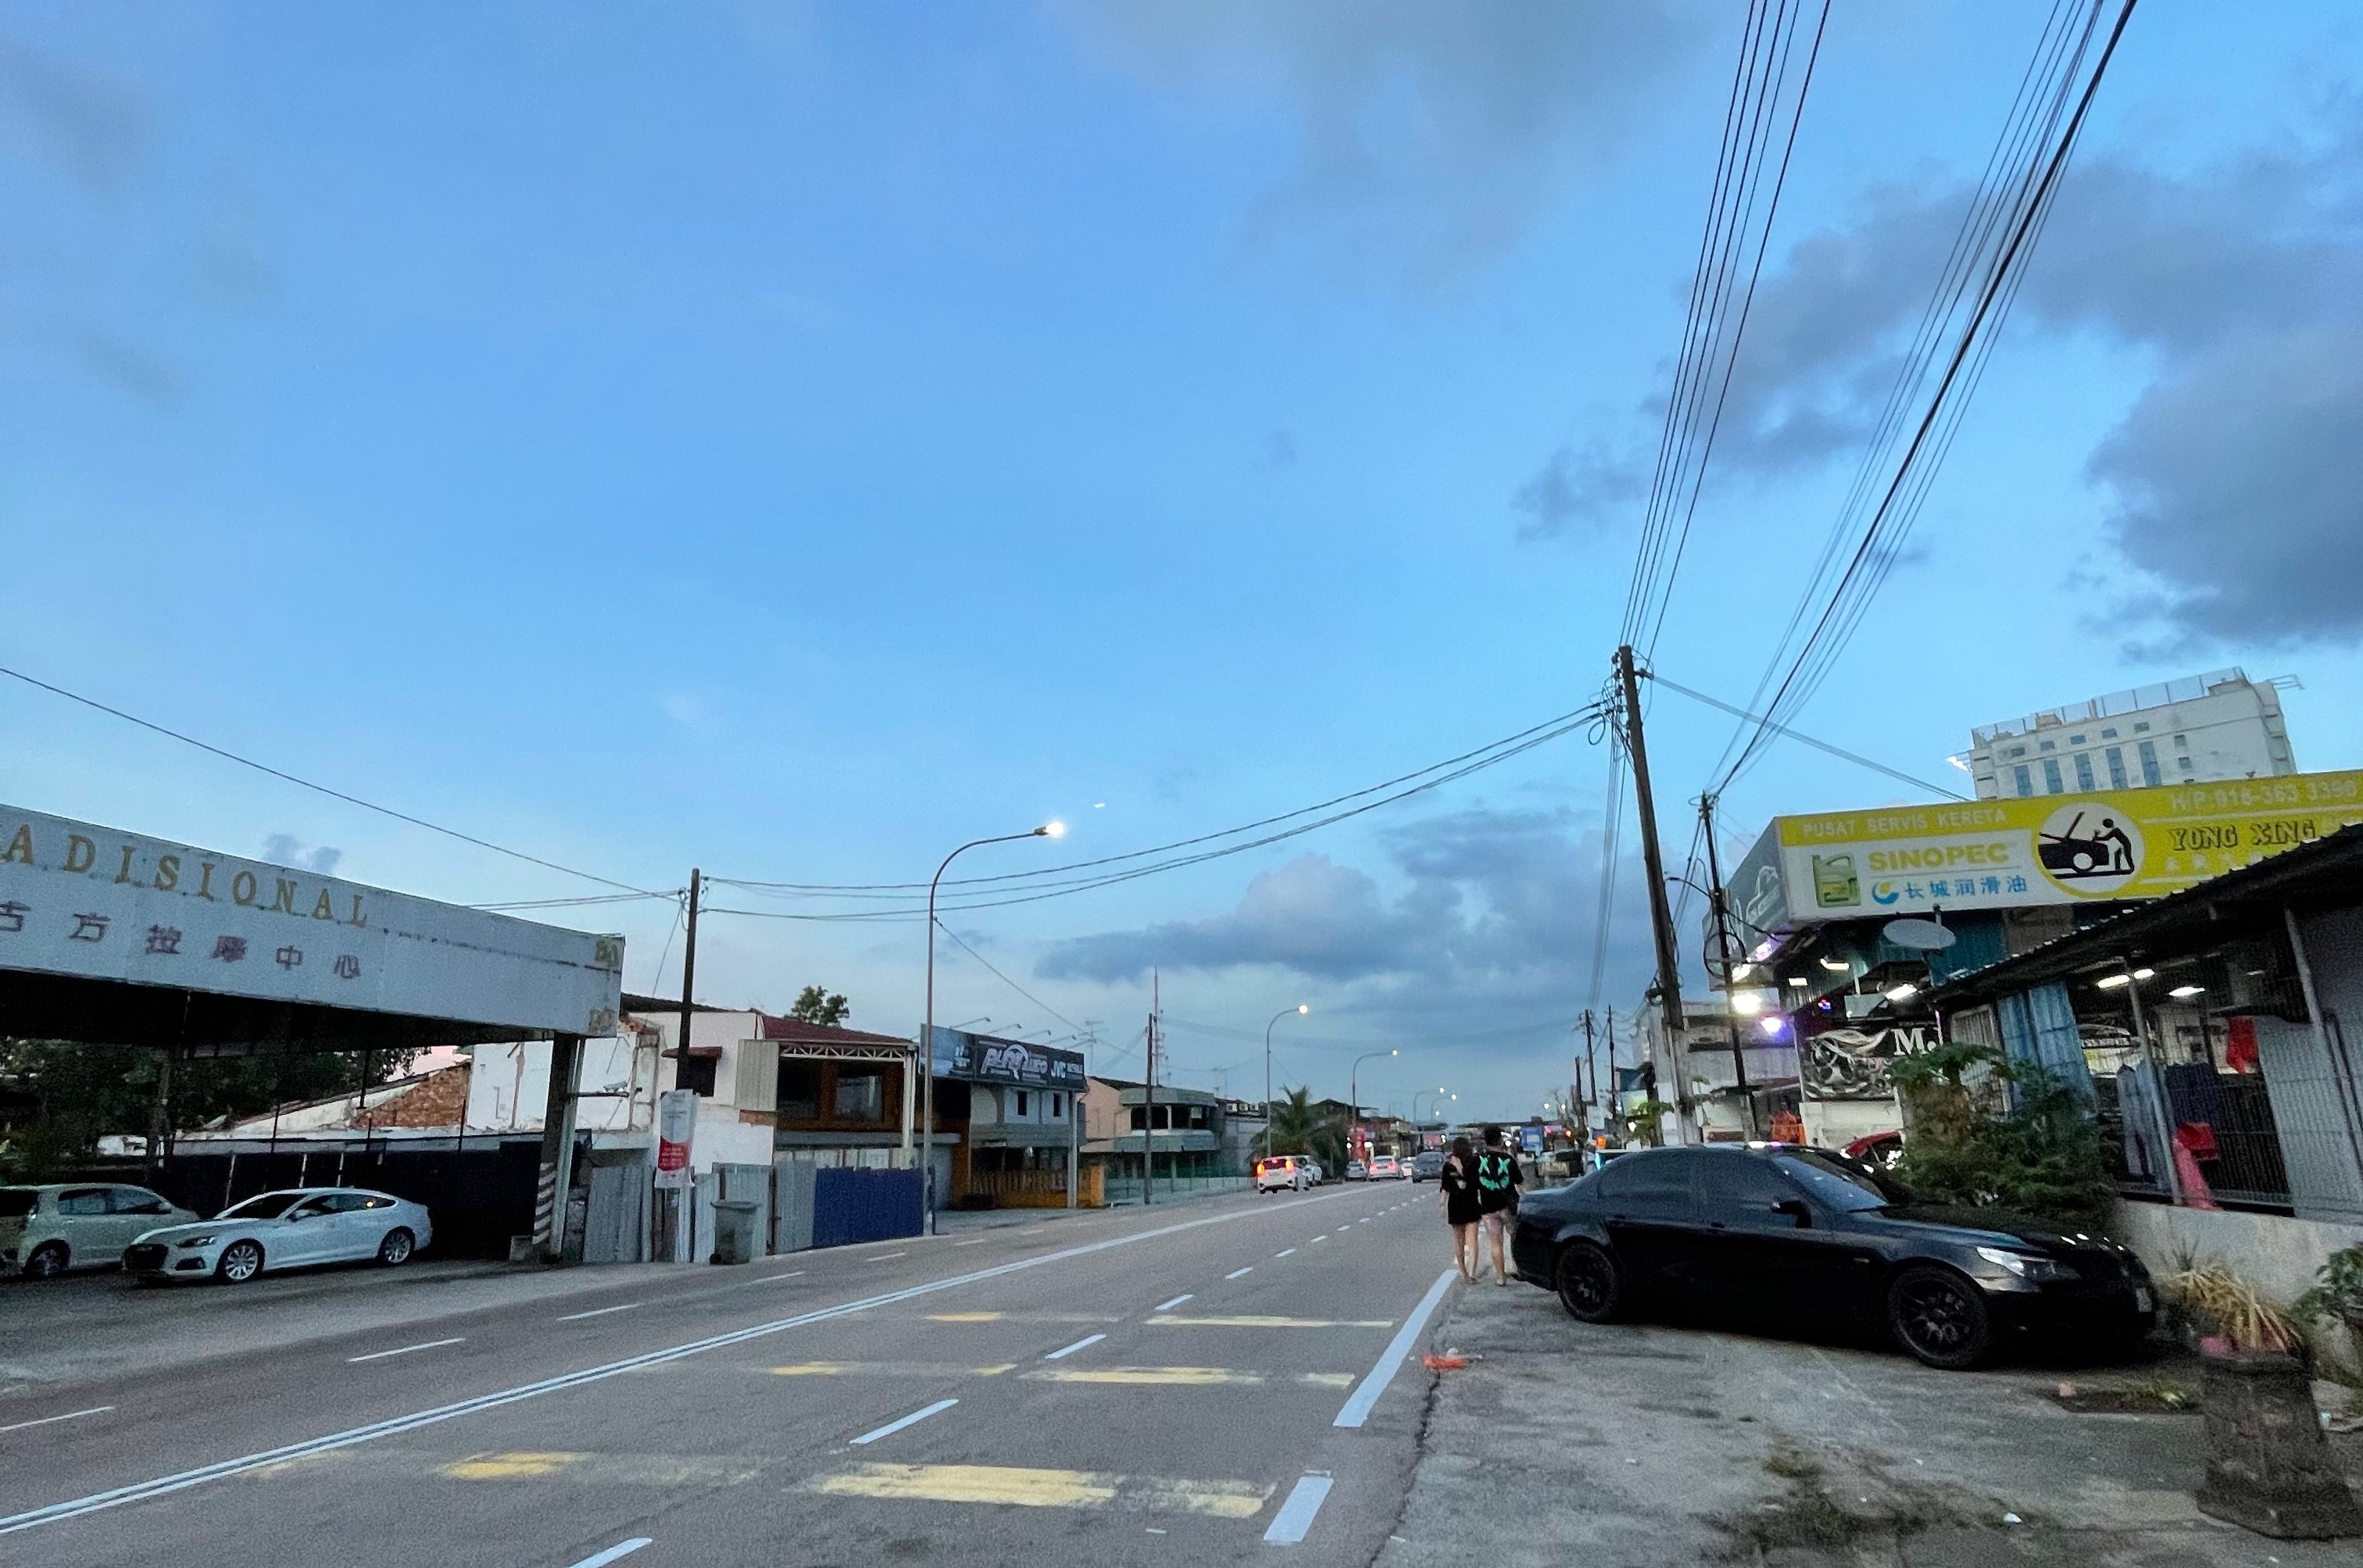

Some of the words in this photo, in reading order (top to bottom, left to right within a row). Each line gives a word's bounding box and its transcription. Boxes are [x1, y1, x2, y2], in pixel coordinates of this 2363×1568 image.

[1803, 820, 1856, 838] PUSAT
[1867, 813, 1929, 833] SERVIS
[1937, 808, 2007, 827] KERETA
[2168, 824, 2238, 851] YONG
[2250, 819, 2317, 846] XING
[1868, 841, 2010, 872] SINOPEC
[2, 823, 368, 928] ADISIONAL
[1905, 874, 2029, 899] 长城润滑油
